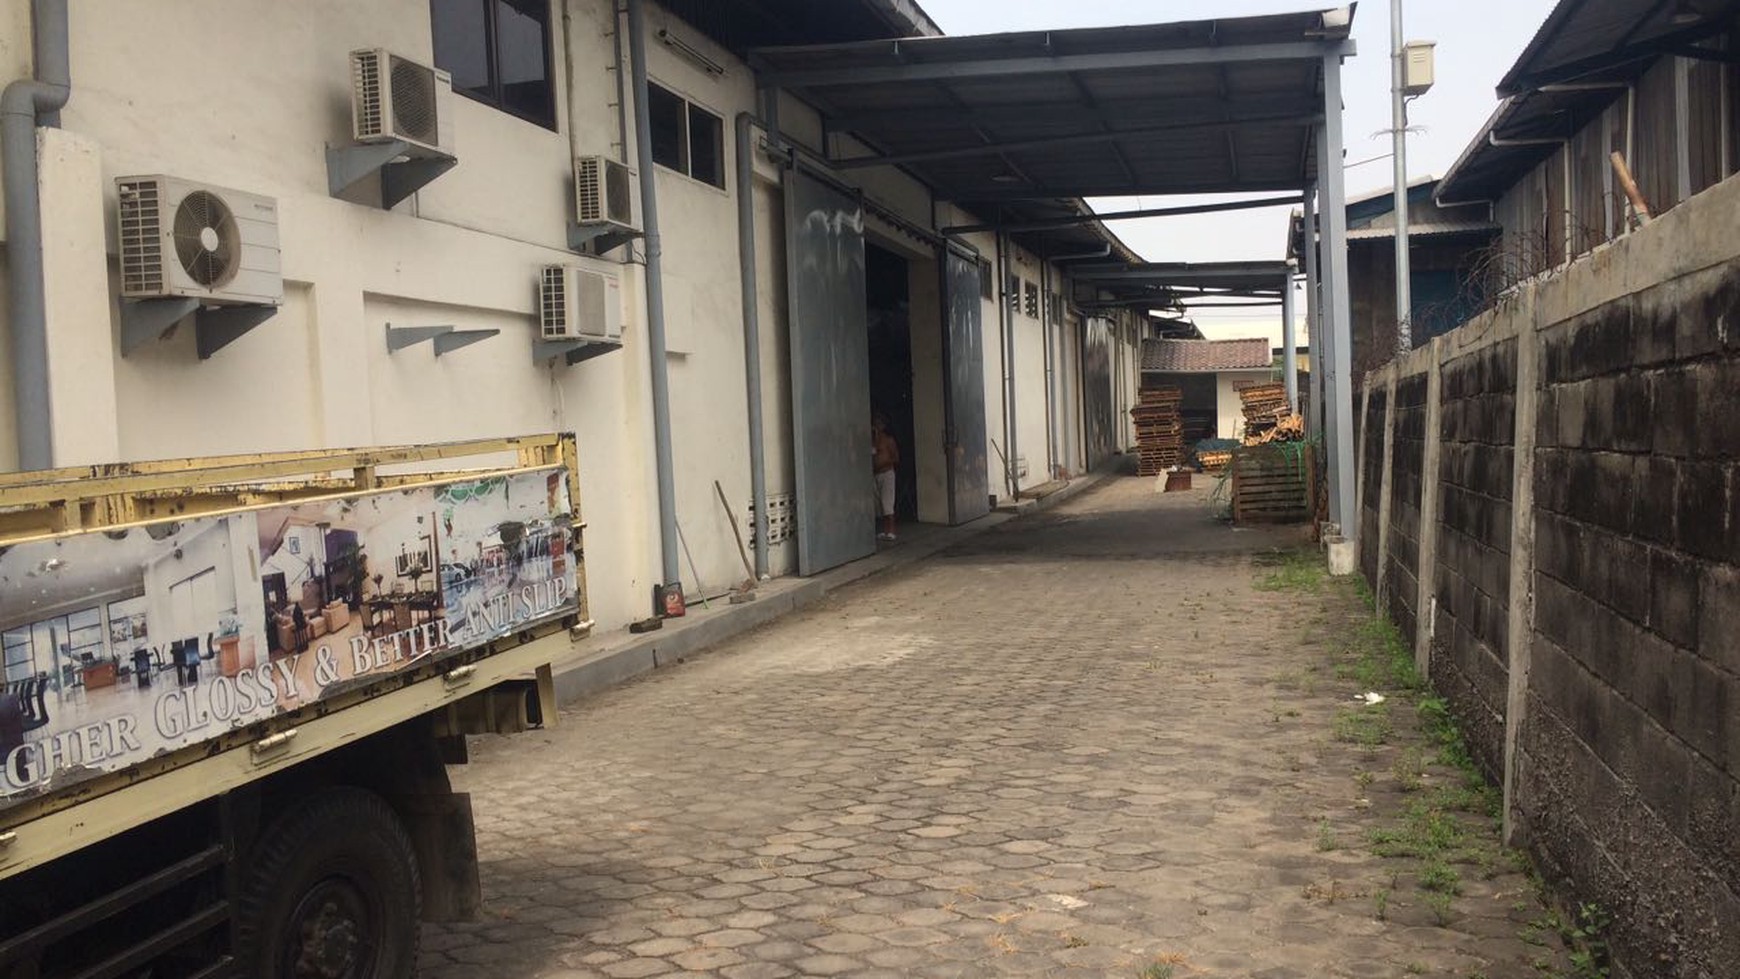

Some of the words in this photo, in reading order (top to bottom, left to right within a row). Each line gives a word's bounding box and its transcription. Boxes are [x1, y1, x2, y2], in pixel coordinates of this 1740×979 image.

[154, 655, 300, 740] GLOSSY
[314, 645, 340, 687] &
[462, 592, 516, 639] ANTI
[521, 576, 568, 620] SLIP
